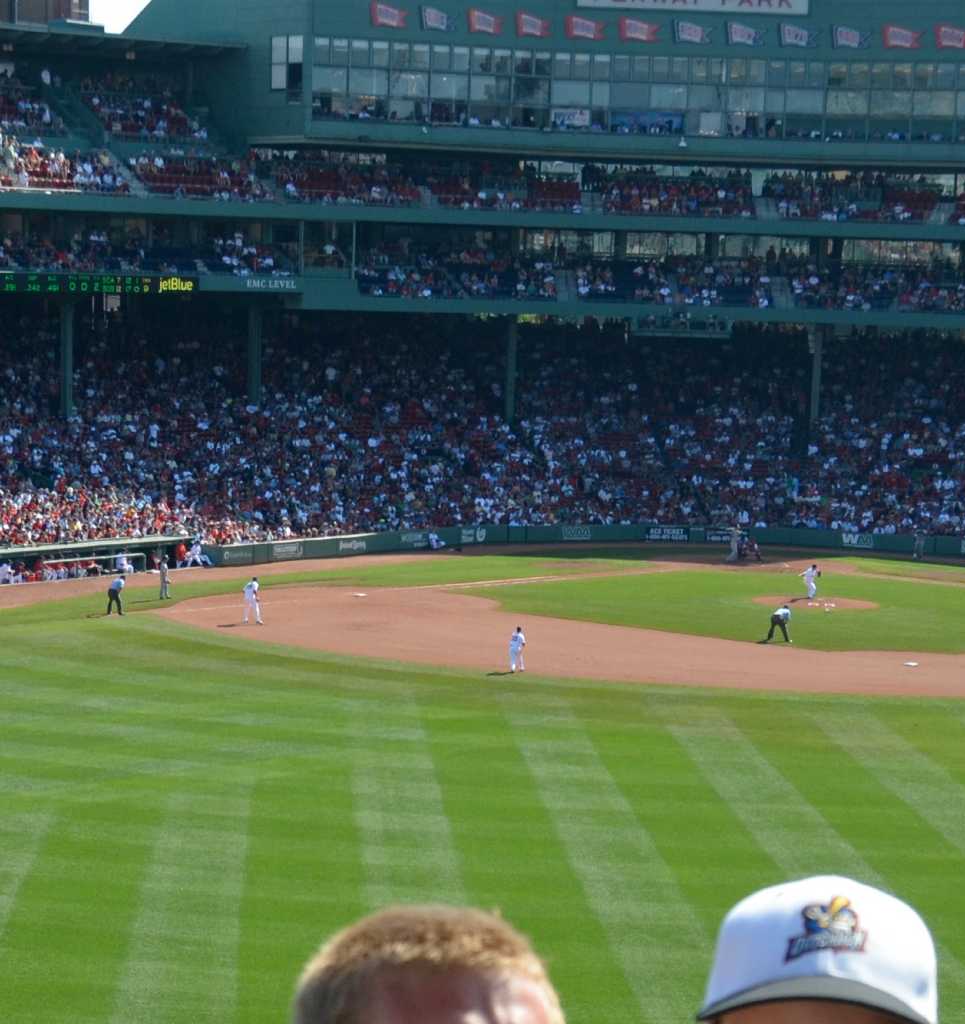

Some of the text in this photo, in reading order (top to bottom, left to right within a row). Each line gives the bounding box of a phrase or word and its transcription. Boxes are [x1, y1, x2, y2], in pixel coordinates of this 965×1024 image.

[158, 277, 194, 293] jetBlue
[246, 279, 297, 289] EMC LEVEL
